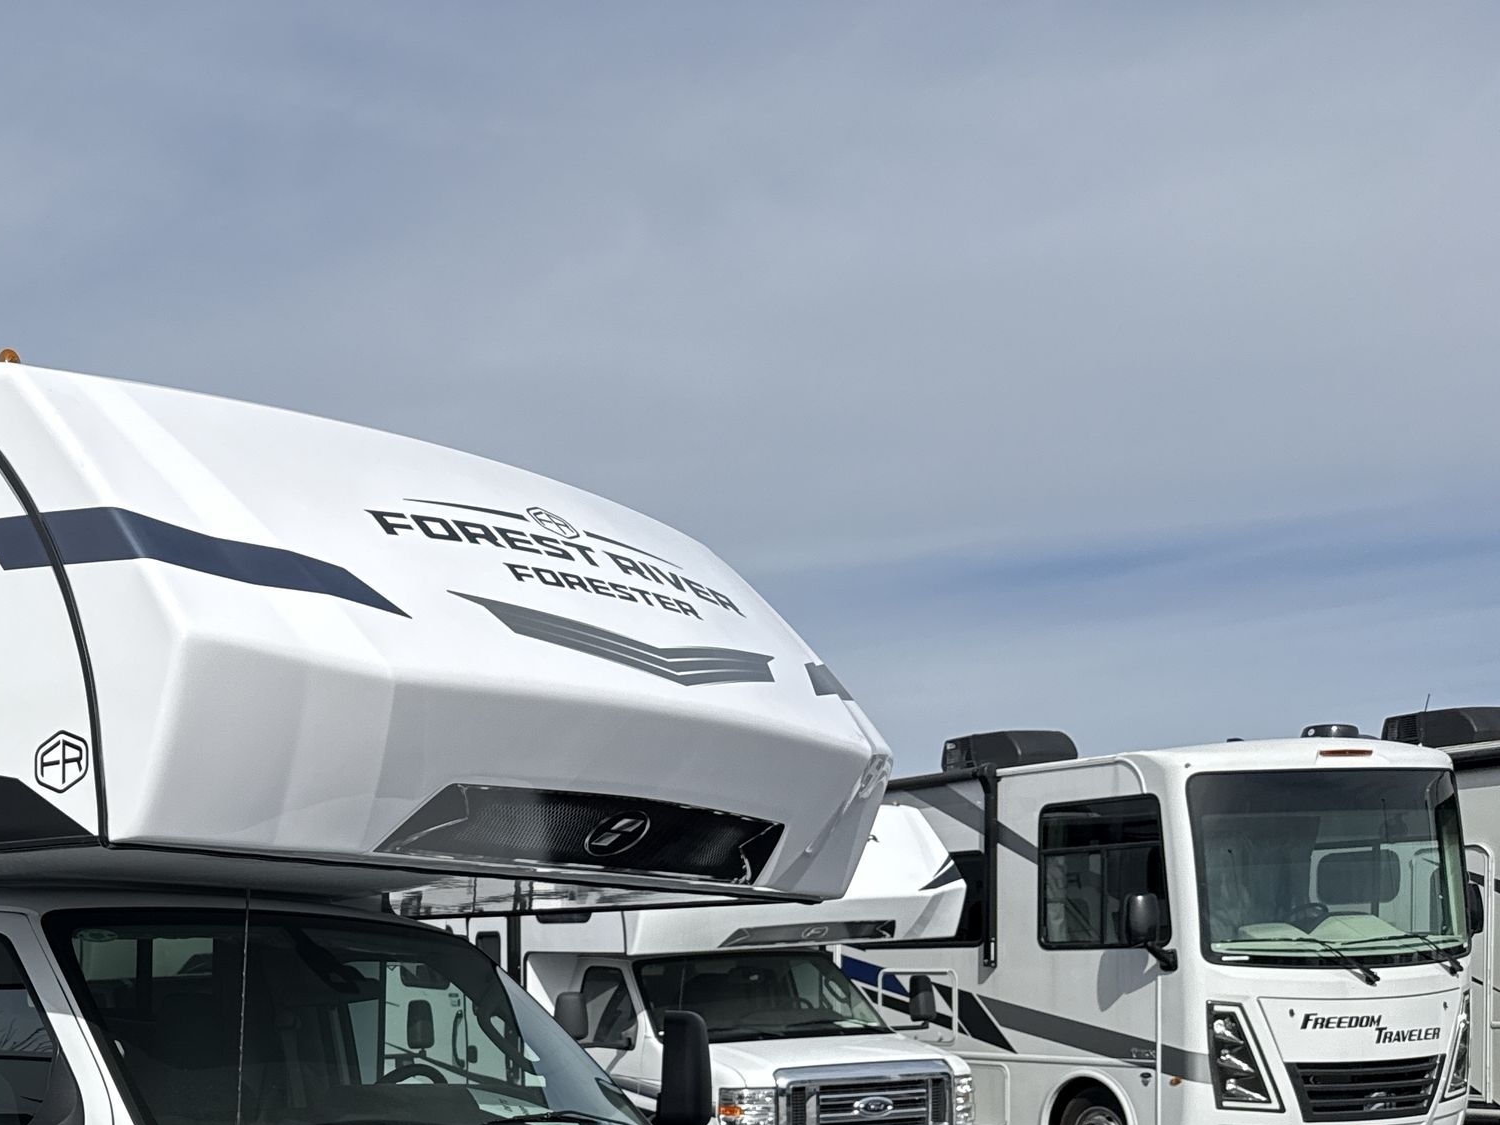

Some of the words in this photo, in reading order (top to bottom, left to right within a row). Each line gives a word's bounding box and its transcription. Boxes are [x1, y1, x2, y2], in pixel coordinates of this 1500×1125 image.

[364, 509, 599, 567] FOREST
[603, 550, 747, 618] RIVER
[503, 562, 704, 620] FORESTER
[1300, 1012, 1382, 1030] FREEDOM
[1375, 1026, 1441, 1044] TRAVELER
